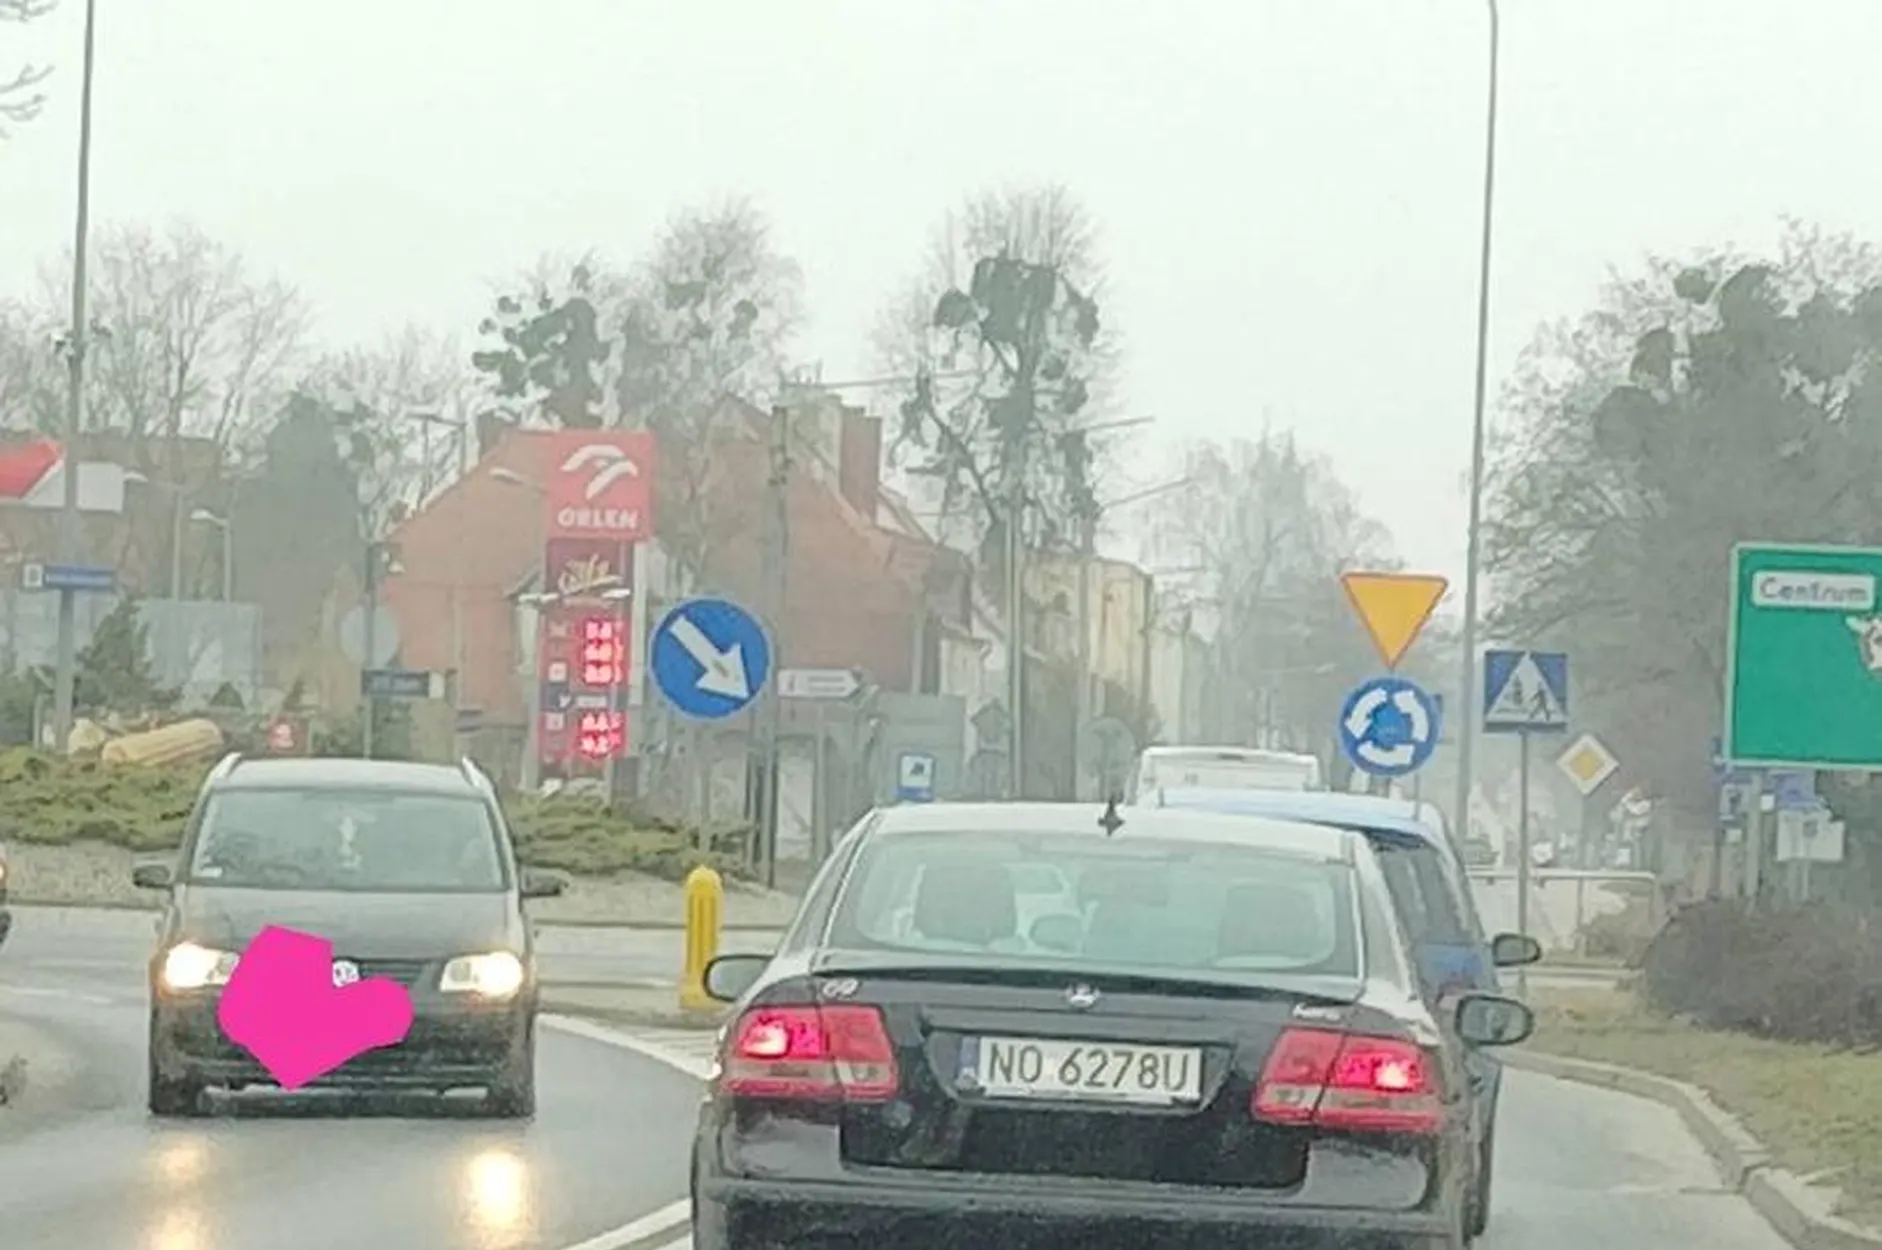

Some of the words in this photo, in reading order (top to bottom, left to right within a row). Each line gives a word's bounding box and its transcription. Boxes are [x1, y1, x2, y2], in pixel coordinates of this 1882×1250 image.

[557, 507, 639, 529] ORLEN
[1760, 576, 1868, 602] Centrum
[988, 1042, 1043, 1084] NO
[1058, 1046, 1189, 1092] 6278U
